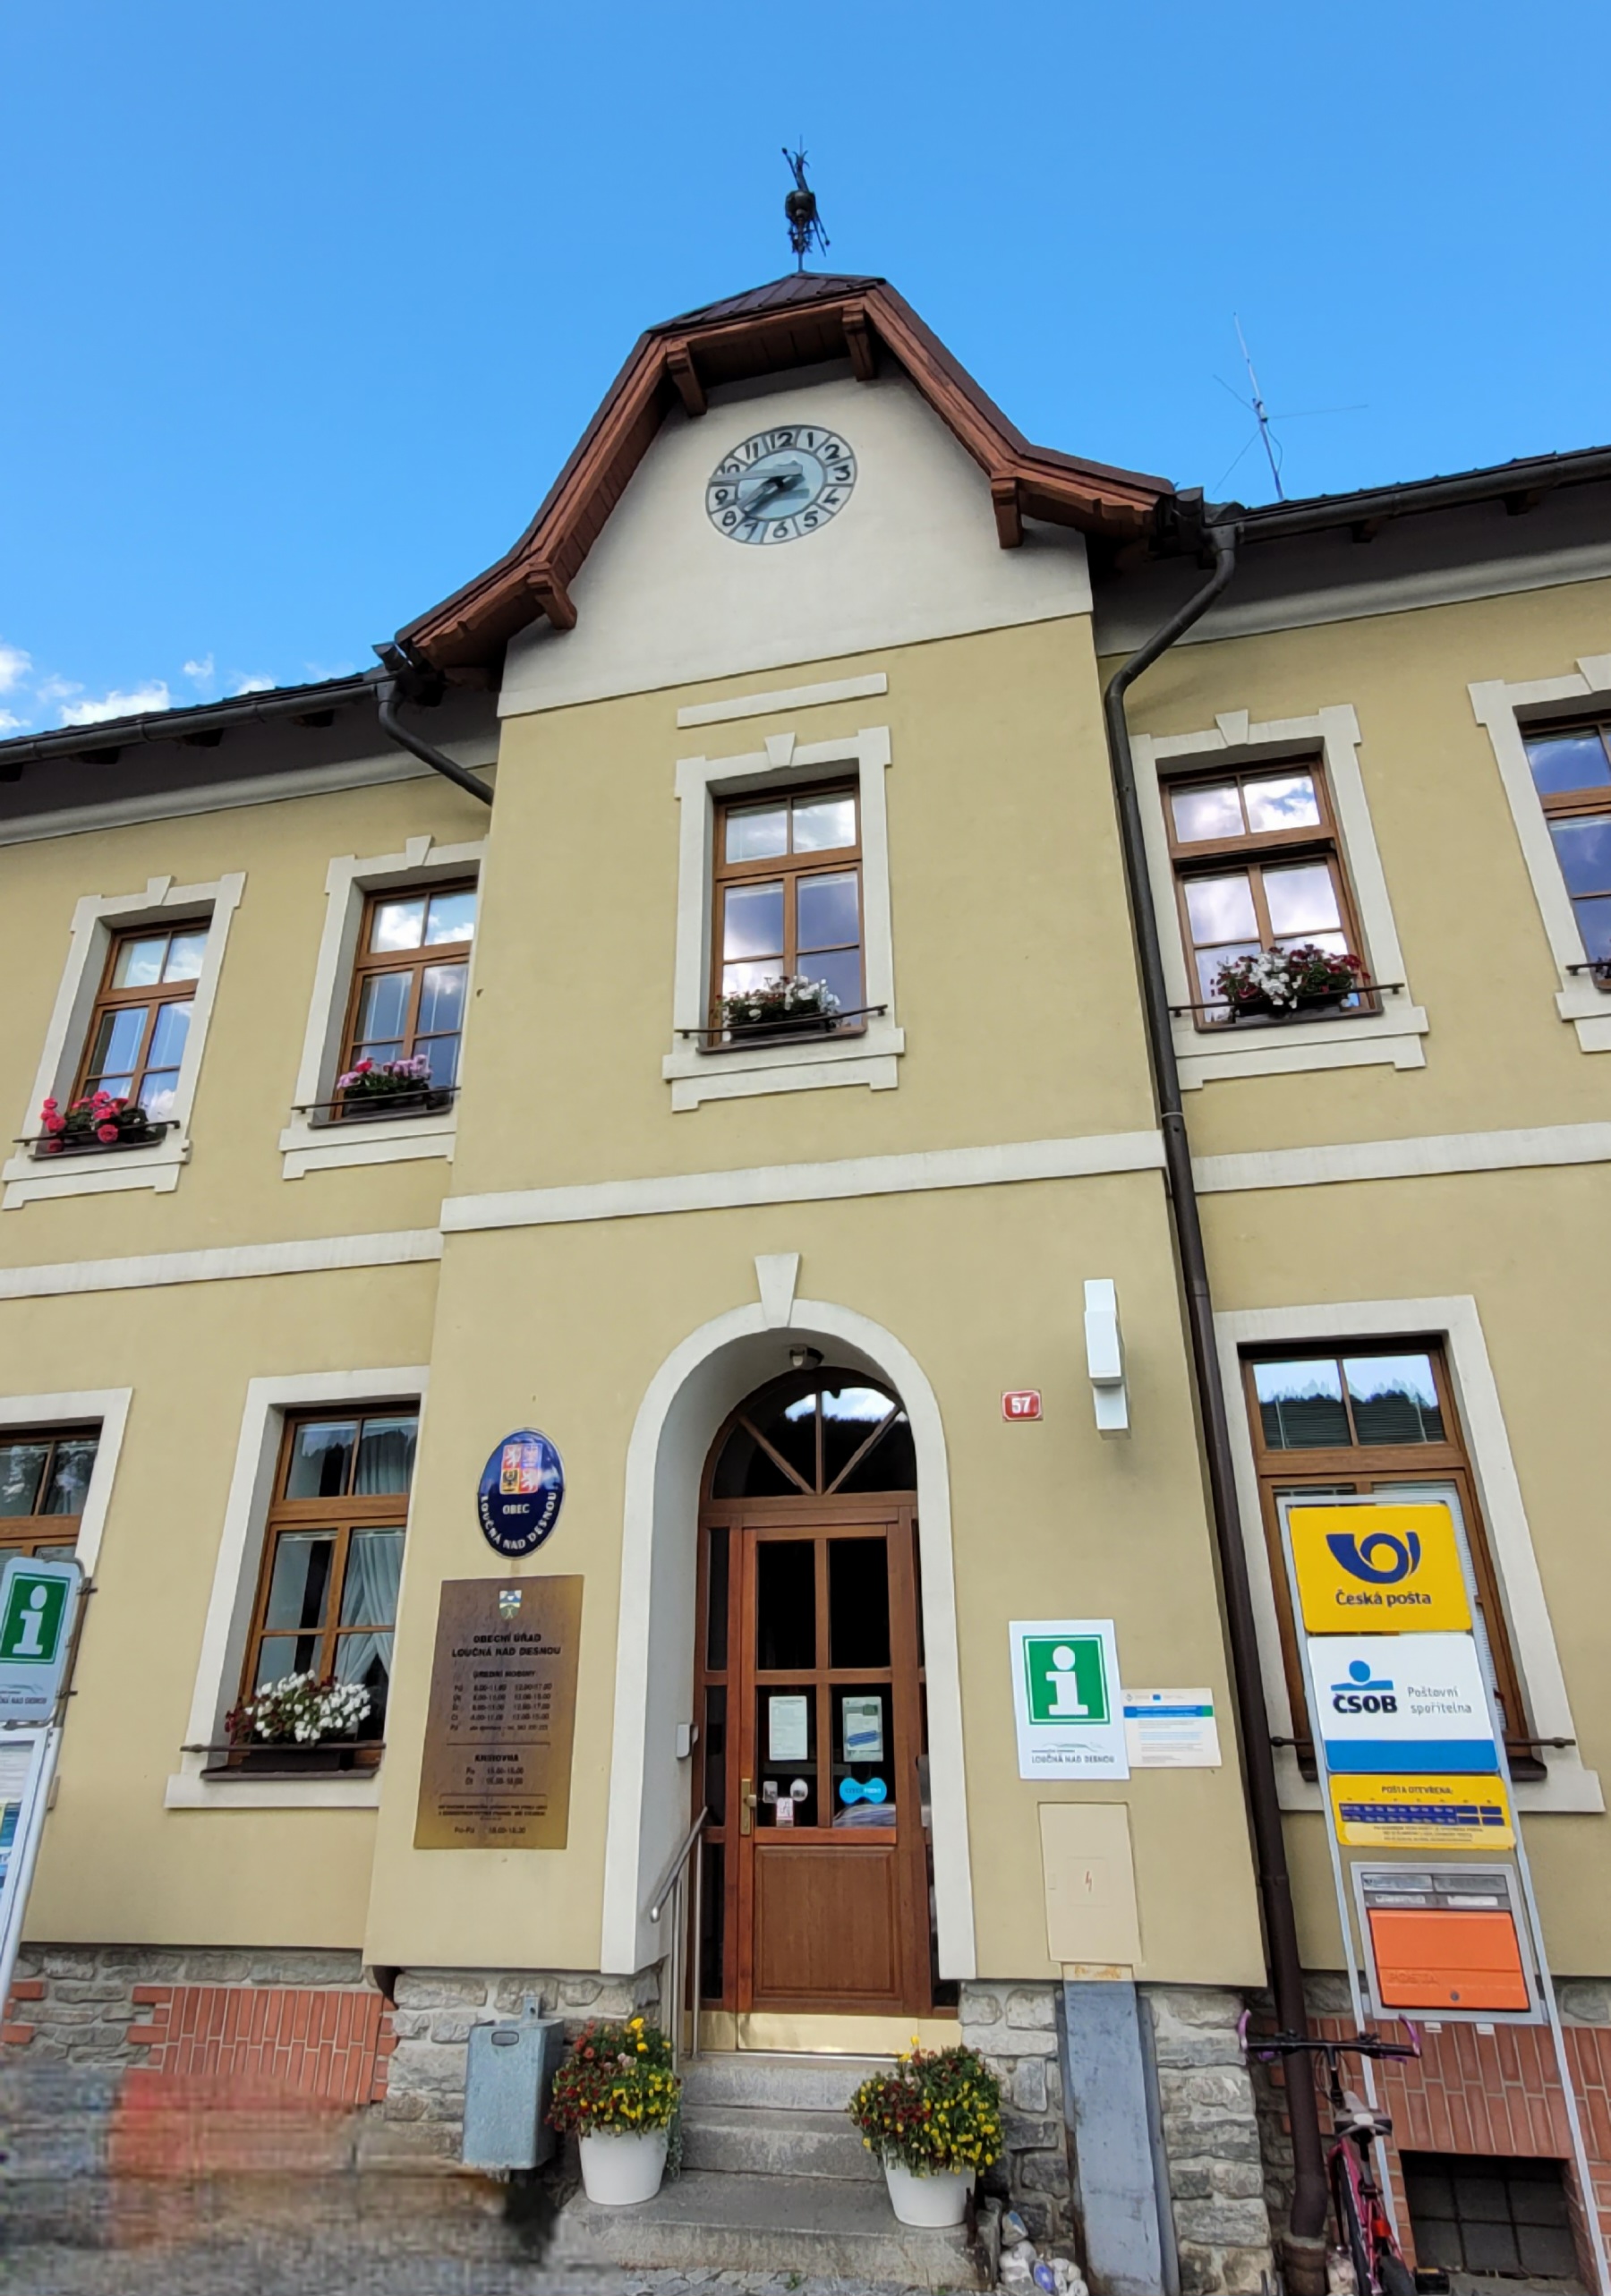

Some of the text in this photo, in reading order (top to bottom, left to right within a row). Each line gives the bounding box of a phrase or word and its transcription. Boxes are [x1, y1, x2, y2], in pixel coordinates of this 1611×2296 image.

[771, 431, 794, 449] 12
[806, 431, 814, 448] 1
[745, 442, 759, 460] 11
[823, 444, 840, 461] 2
[833, 465, 851, 482] 3
[714, 489, 729, 506] 9
[823, 488, 840, 506] 4
[721, 510, 737, 527] 8
[803, 510, 819, 528] 5
[744, 522, 759, 542] 7
[772, 521, 788, 538] 6
[1010, 1396, 1031, 1414] 57
[502, 1503, 531, 1515] OBEC
[502, 1538, 526, 1550] NAD
[526, 1491, 558, 1543] DESNOU
[1335, 1589, 1432, 1608] Česká pošta
[495, 1645, 516, 1656] NAD
[519, 1645, 562, 1656] DESNOU
[1407, 1686, 1460, 1698] Poštovní
[1332, 1694, 1398, 1714] ČSOB
[1411, 1703, 1472, 1716] spořitelna
[1064, 1754, 1083, 1763] NAD
[1381, 1785, 1407, 1794] POŠTA
